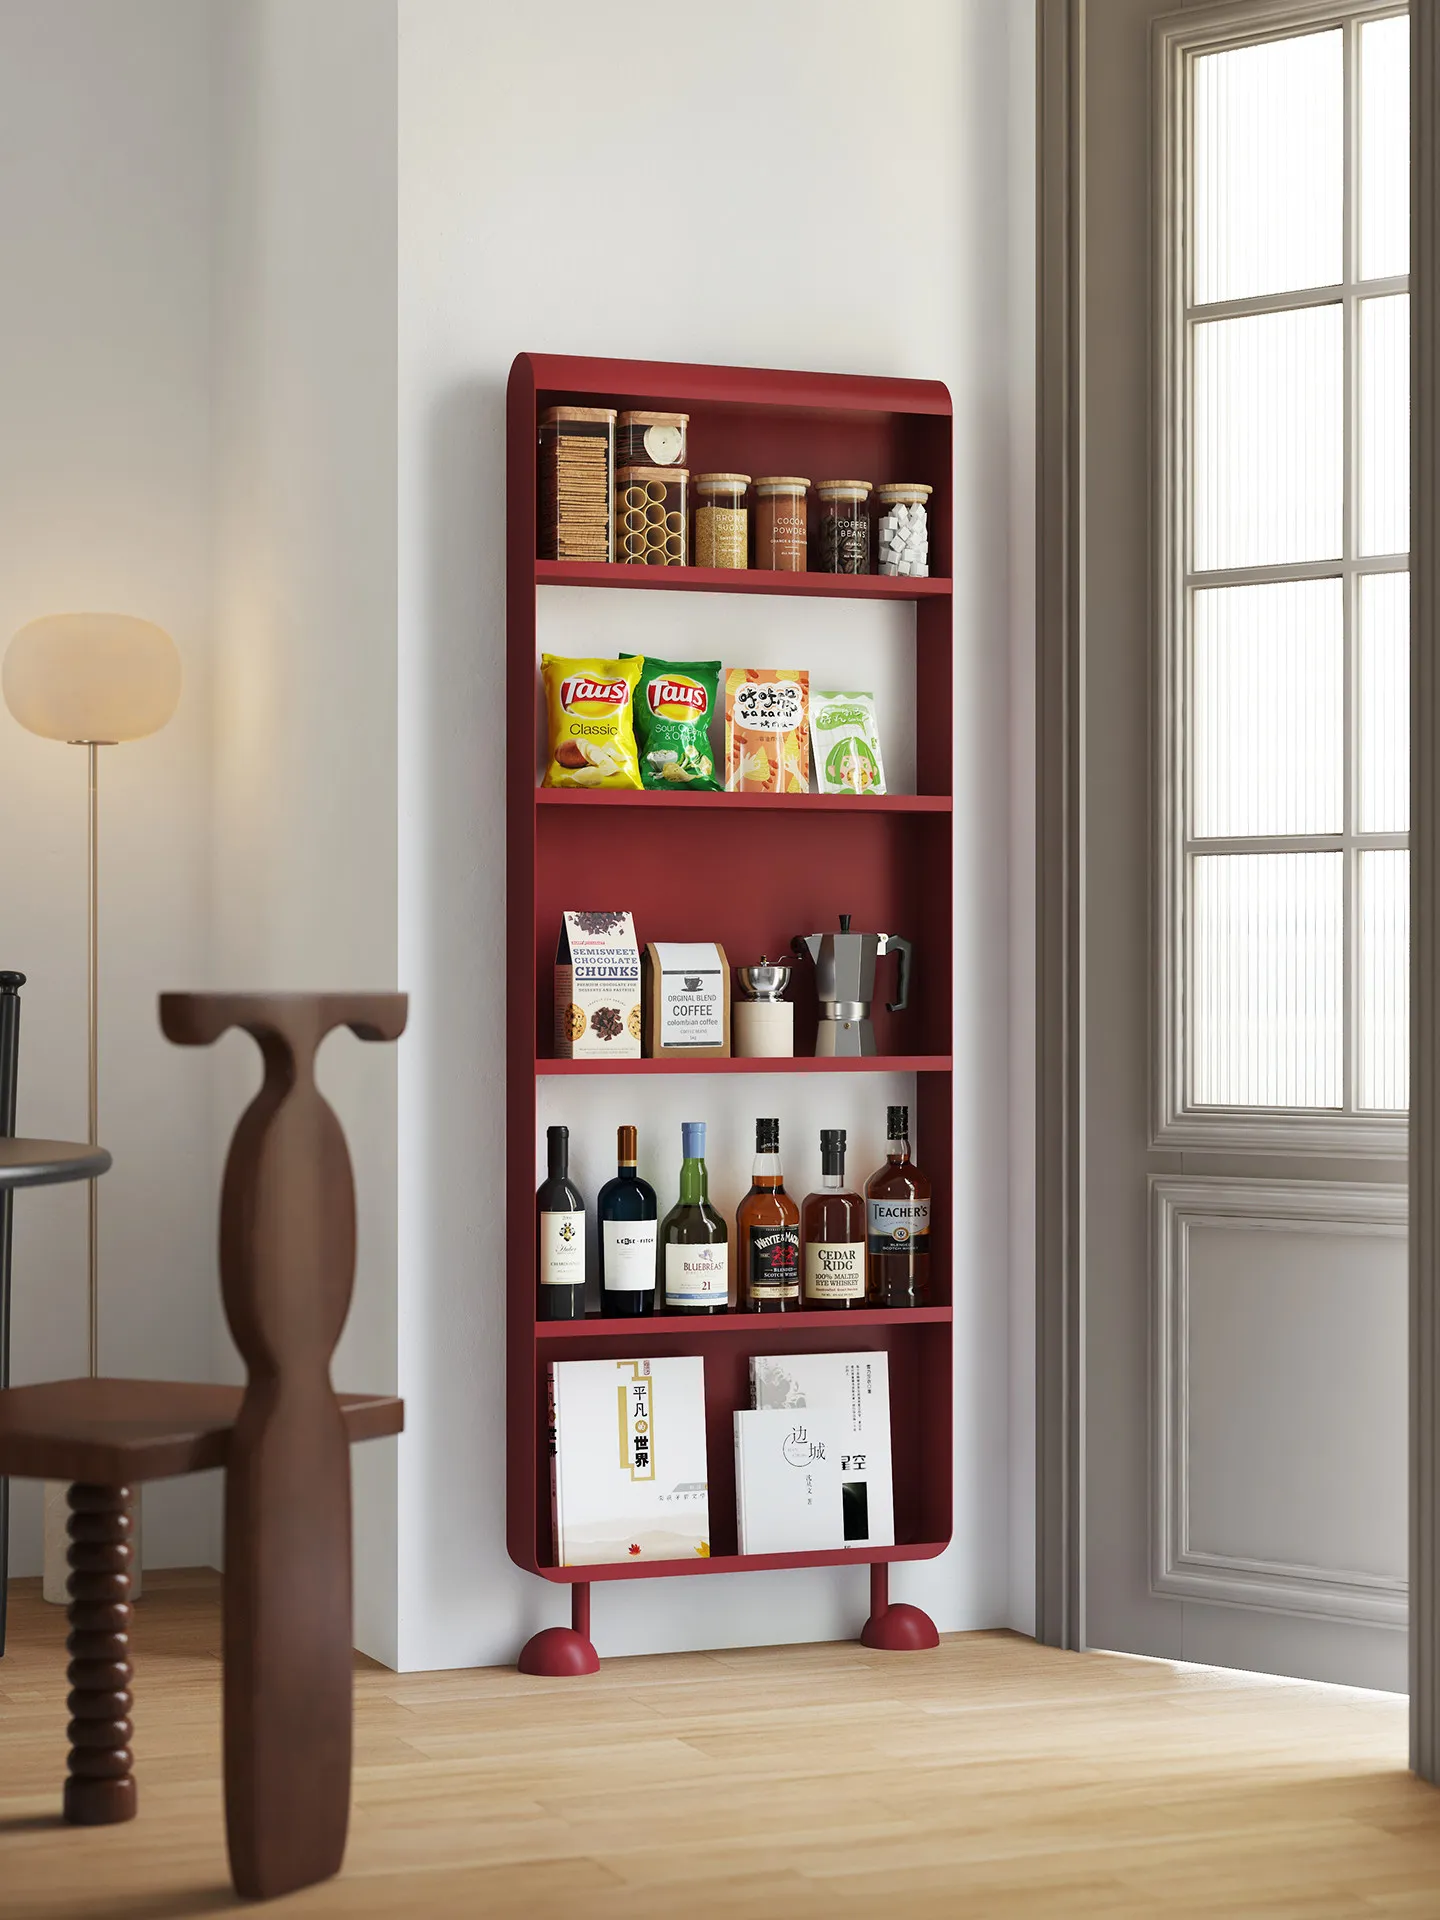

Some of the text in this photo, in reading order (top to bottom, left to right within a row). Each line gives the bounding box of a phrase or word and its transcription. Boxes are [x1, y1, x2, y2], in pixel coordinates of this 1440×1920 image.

[777, 517, 804, 526] COCOA
[838, 520, 867, 530] COFFEE
[773, 526, 806, 535] POWDER
[841, 530, 866, 539] BEANS
[563, 677, 626, 705] Taus
[649, 680, 704, 707] Taus
[569, 723, 618, 735] Classic
[655, 723, 676, 733] Sour
[665, 732, 671, 741] &
[572, 948, 636, 956] SEMISWEET
[574, 957, 638, 965] CHOCOLATE
[575, 966, 639, 977] CHUNKS
[667, 994, 717, 1003] ORGINAL BLEND
[672, 1004, 713, 1017] COFFEE
[667, 1017, 719, 1026] colombian coffee
[873, 1203, 928, 1220] TEACHER'S
[754, 1233, 781, 1250] WHYTE
[818, 1249, 856, 1260] CEDAR
[683, 1261, 725, 1271] BLUEBREAST
[822, 1260, 853, 1271] RIDG
[701, 1281, 711, 1291] 21
[632, 1385, 650, 1468] 平凡的世界
